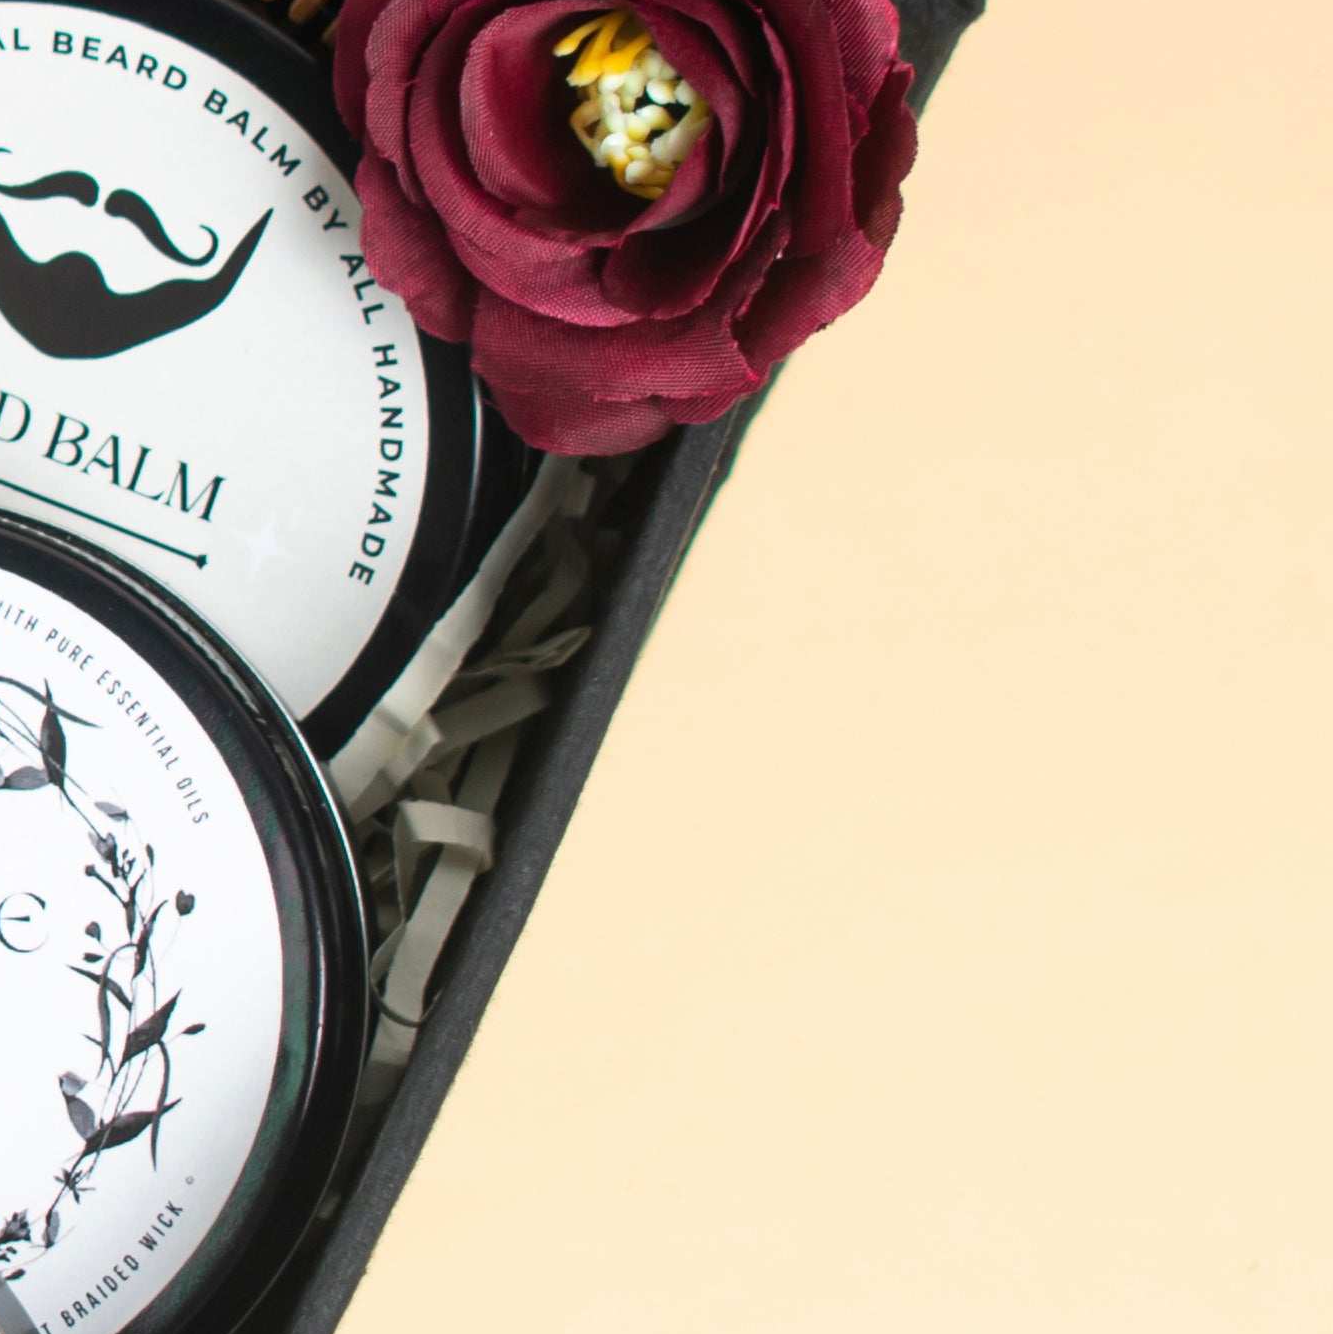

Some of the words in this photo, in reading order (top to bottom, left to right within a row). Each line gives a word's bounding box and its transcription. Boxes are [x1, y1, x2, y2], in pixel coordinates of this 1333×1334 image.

[52, 30, 189, 92] BEARD
[202, 88, 303, 178] BALM
[301, 184, 349, 233] BY
[339, 252, 385, 326] ALL
[42, 412, 227, 523] BALM
[348, 342, 404, 588] HANDMADE
[44, 627, 95, 672] PURE
[96, 669, 181, 771] ESSENTIAL
[175, 775, 210, 826] OILS
[137, 1199, 185, 1253] WICK
